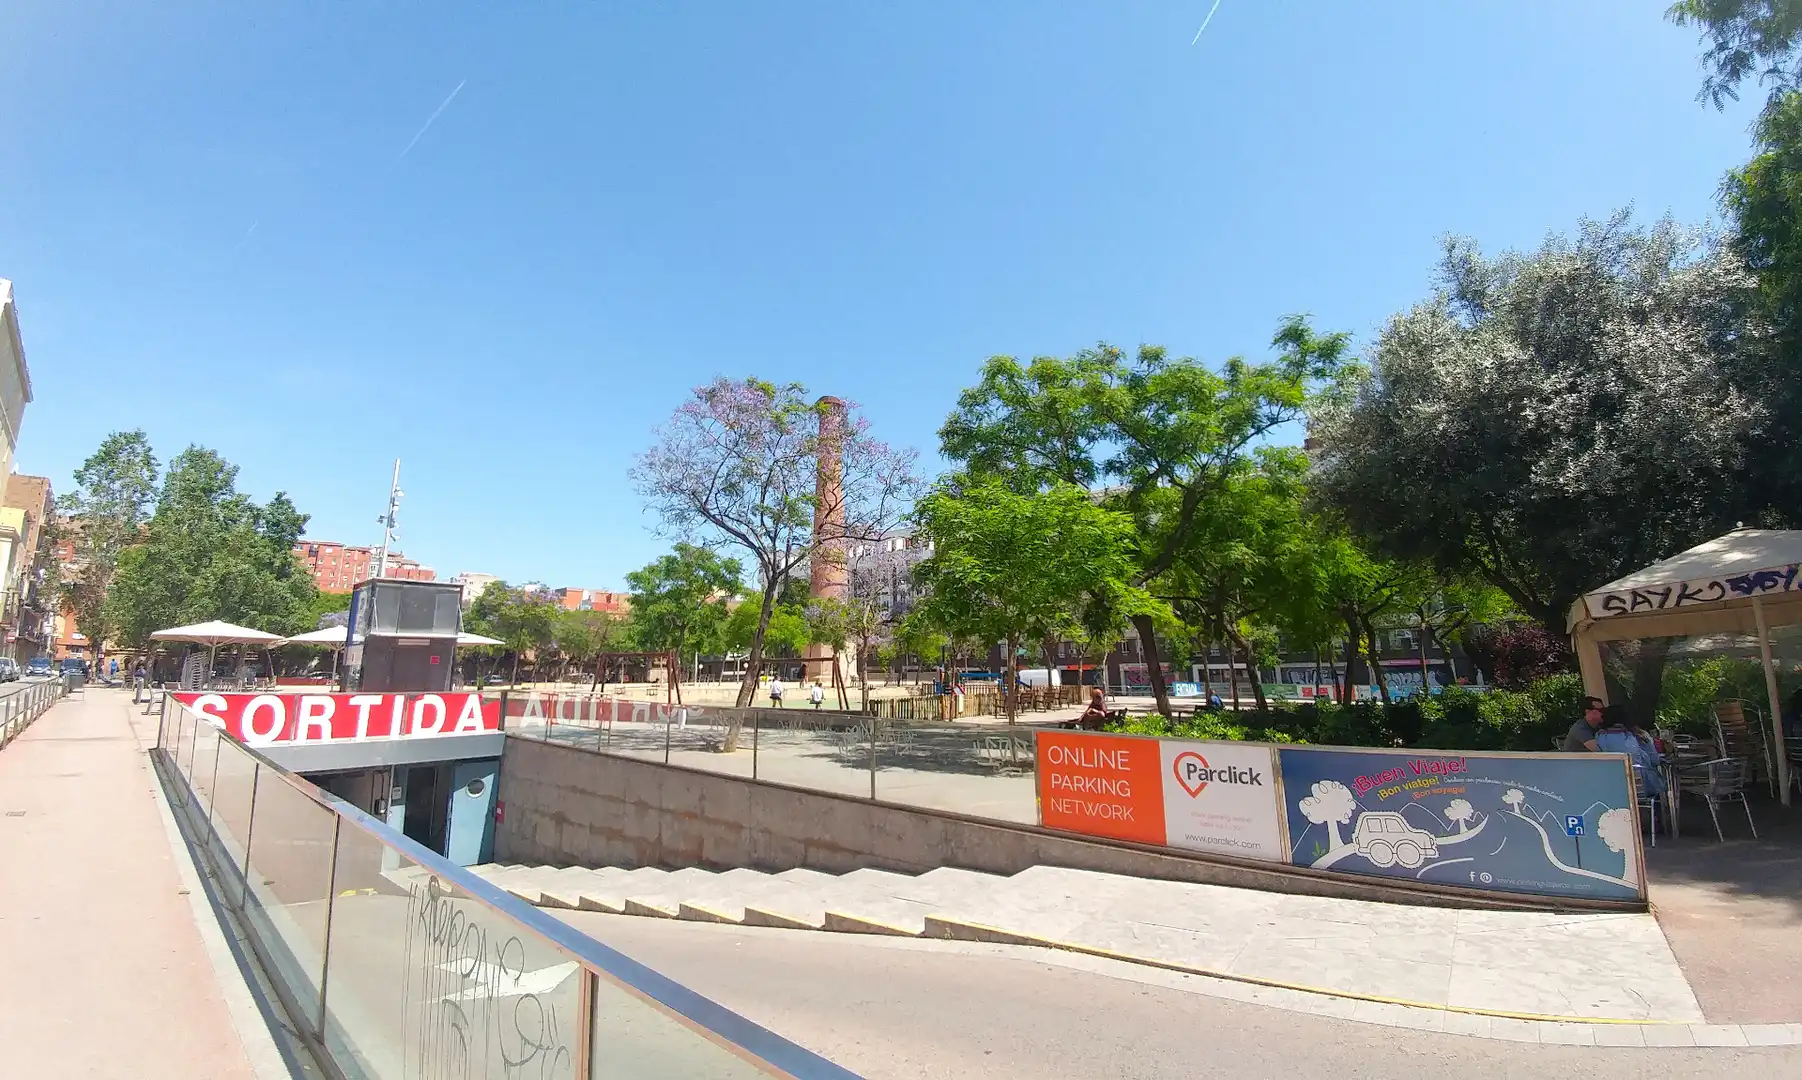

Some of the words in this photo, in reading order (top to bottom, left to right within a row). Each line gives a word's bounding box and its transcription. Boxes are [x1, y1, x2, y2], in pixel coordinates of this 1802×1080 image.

[191, 694, 486, 743] SORTIDA
[1047, 745, 1131, 771] ONLINE
[1051, 773, 1131, 798] PARKING
[1186, 762, 1263, 787] Parclick
[1352, 766, 1406, 798] ¡Buen
[1407, 756, 1468, 776] Viaje!
[1377, 785, 1401, 801] ¡Bon
[1402, 776, 1440, 791] viatge!
[1051, 797, 1135, 822] NETWORK
[1185, 833, 1262, 850] www.parclick.com
